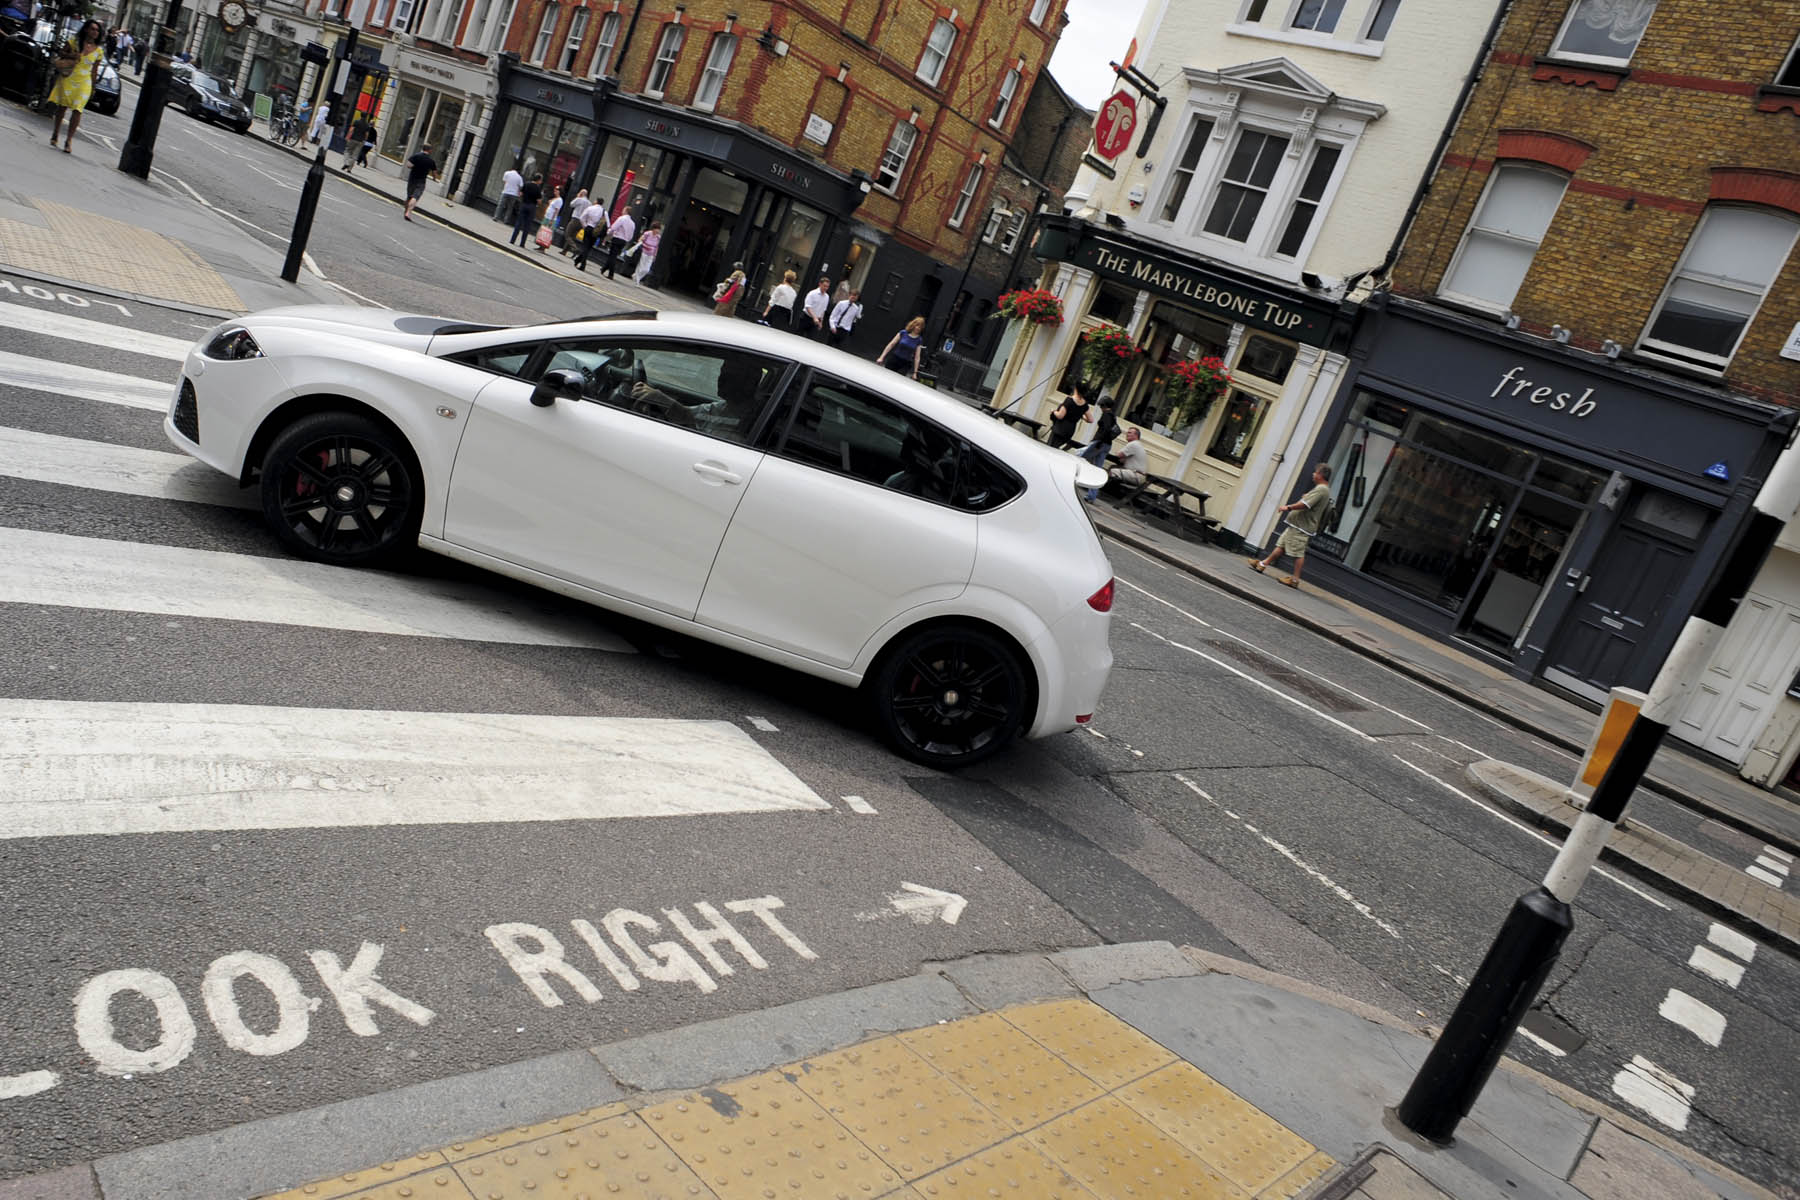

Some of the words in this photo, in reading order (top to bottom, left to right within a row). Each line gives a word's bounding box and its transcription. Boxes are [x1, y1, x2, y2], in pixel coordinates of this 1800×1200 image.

[645, 119, 681, 138] SHOON
[770, 162, 811, 189] SHOON
[1095, 247, 1129, 274] THE
[1131, 260, 1259, 317] MARYLEBONE
[1264, 301, 1302, 330] TUP
[1490, 366, 1597, 417] fresh
[484, 895, 820, 1008] RIGHT
